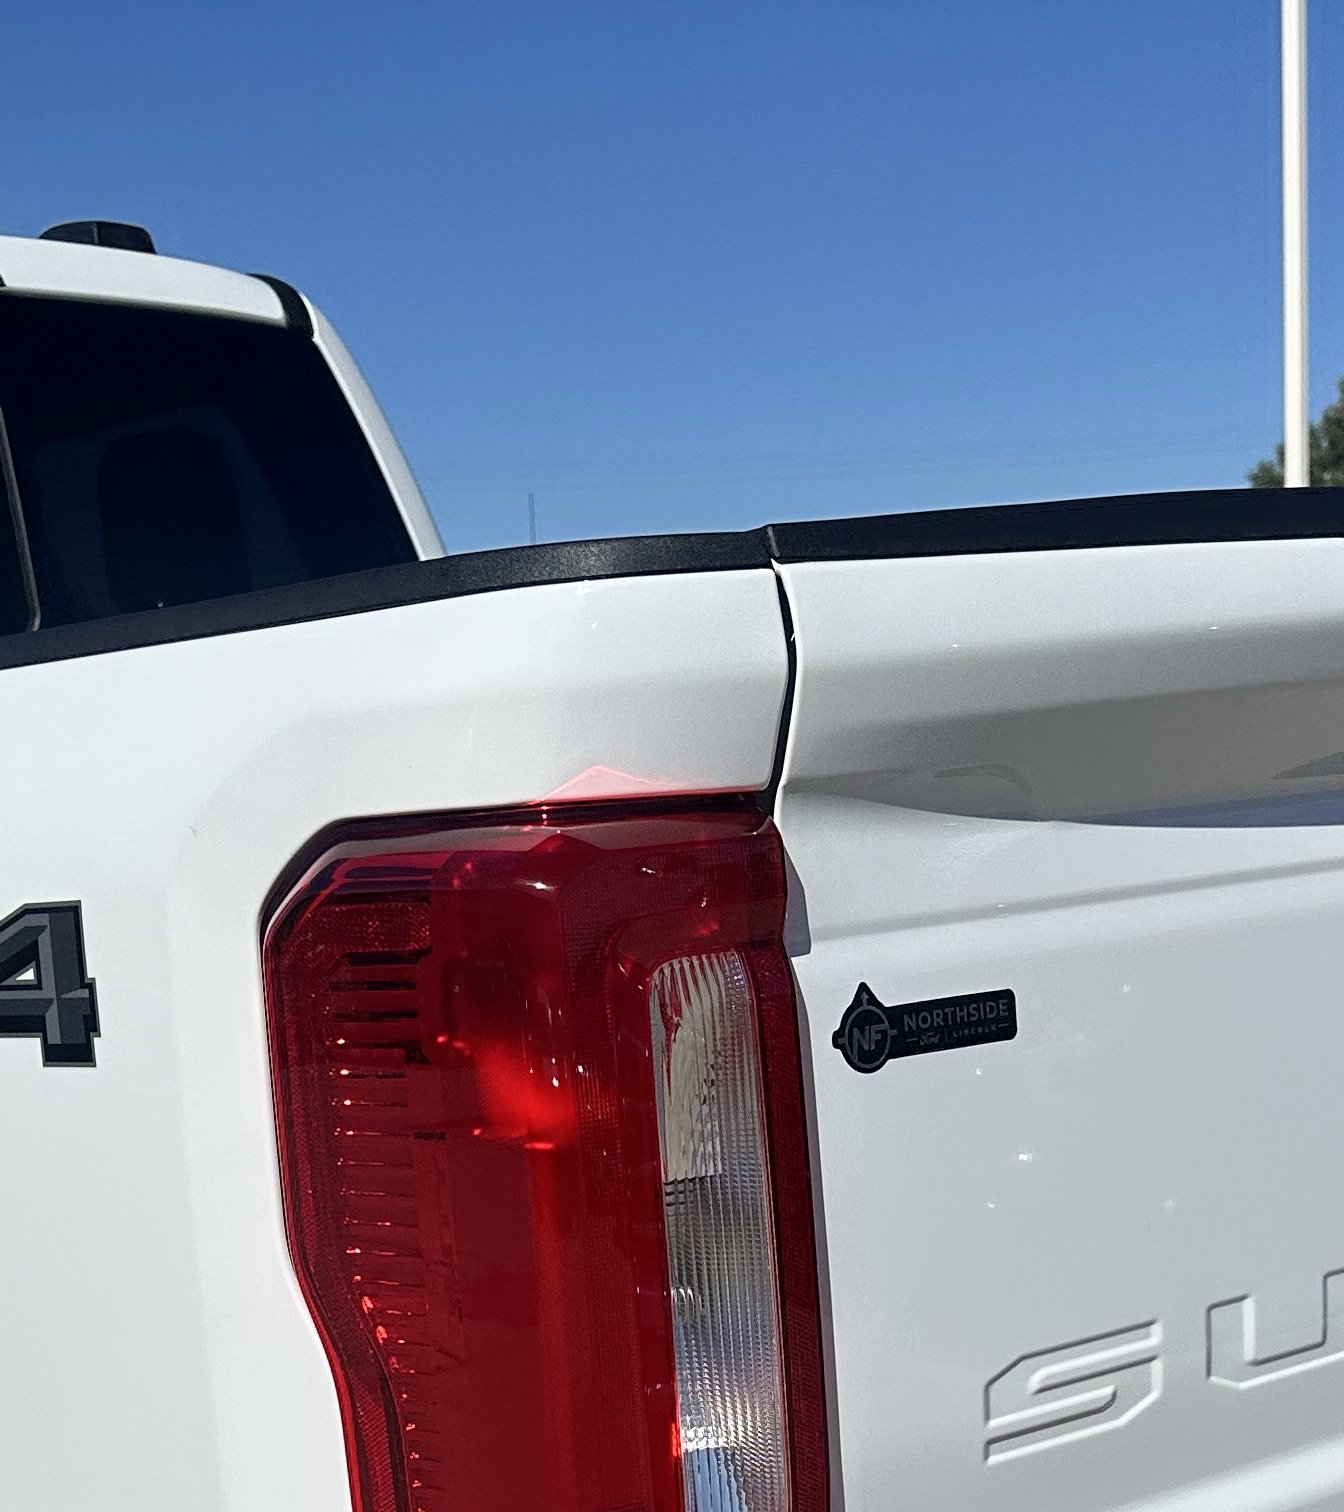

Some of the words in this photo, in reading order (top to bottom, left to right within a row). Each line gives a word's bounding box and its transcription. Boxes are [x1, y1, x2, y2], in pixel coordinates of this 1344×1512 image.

[903, 999, 1010, 1031] NORTHSIDE
[853, 1023, 889, 1052] NF
[952, 1024, 997, 1038] LINCOLN
